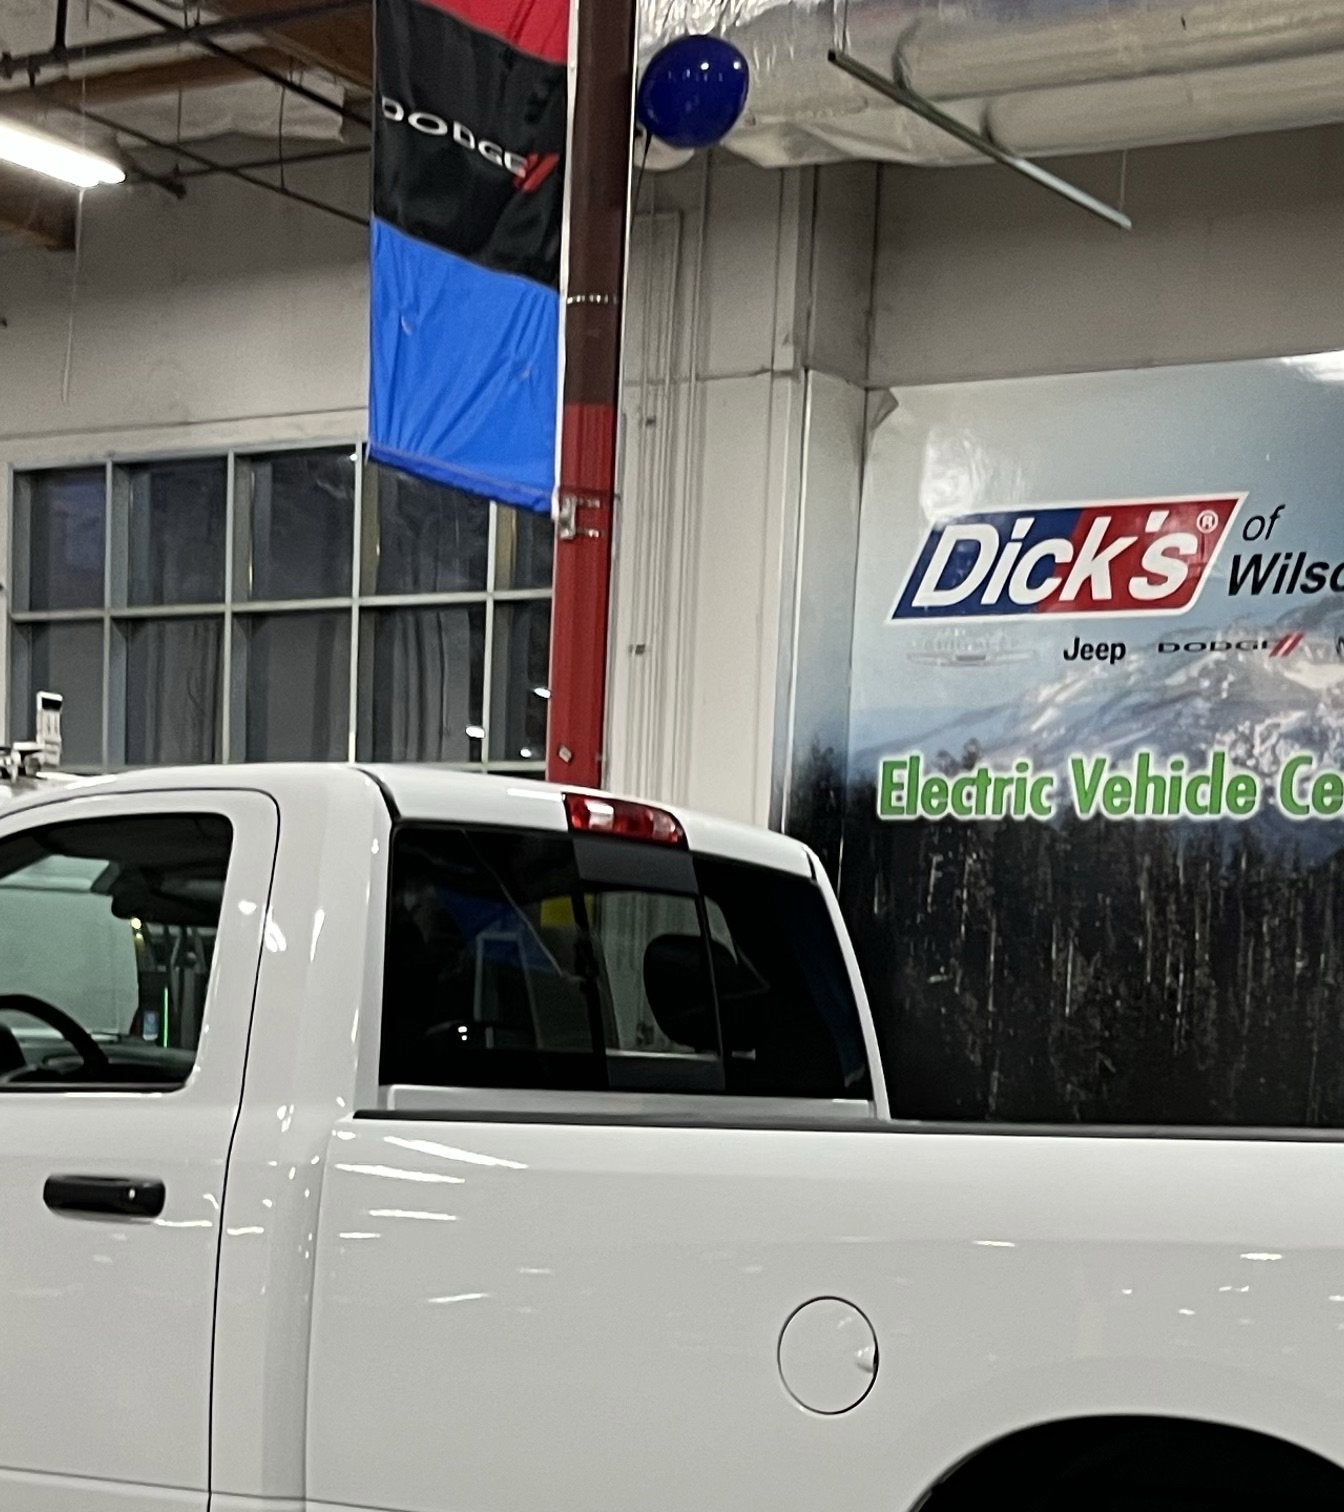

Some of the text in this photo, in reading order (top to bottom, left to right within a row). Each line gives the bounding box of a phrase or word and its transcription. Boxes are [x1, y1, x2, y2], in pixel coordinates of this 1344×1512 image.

[381, 95, 529, 179] DODGE
[1242, 504, 1286, 541] of
[911, 510, 1199, 607] Dick's
[1063, 636, 1127, 664] Jeep
[879, 754, 1054, 816] Electric
[1071, 751, 1256, 816] Vehicle
